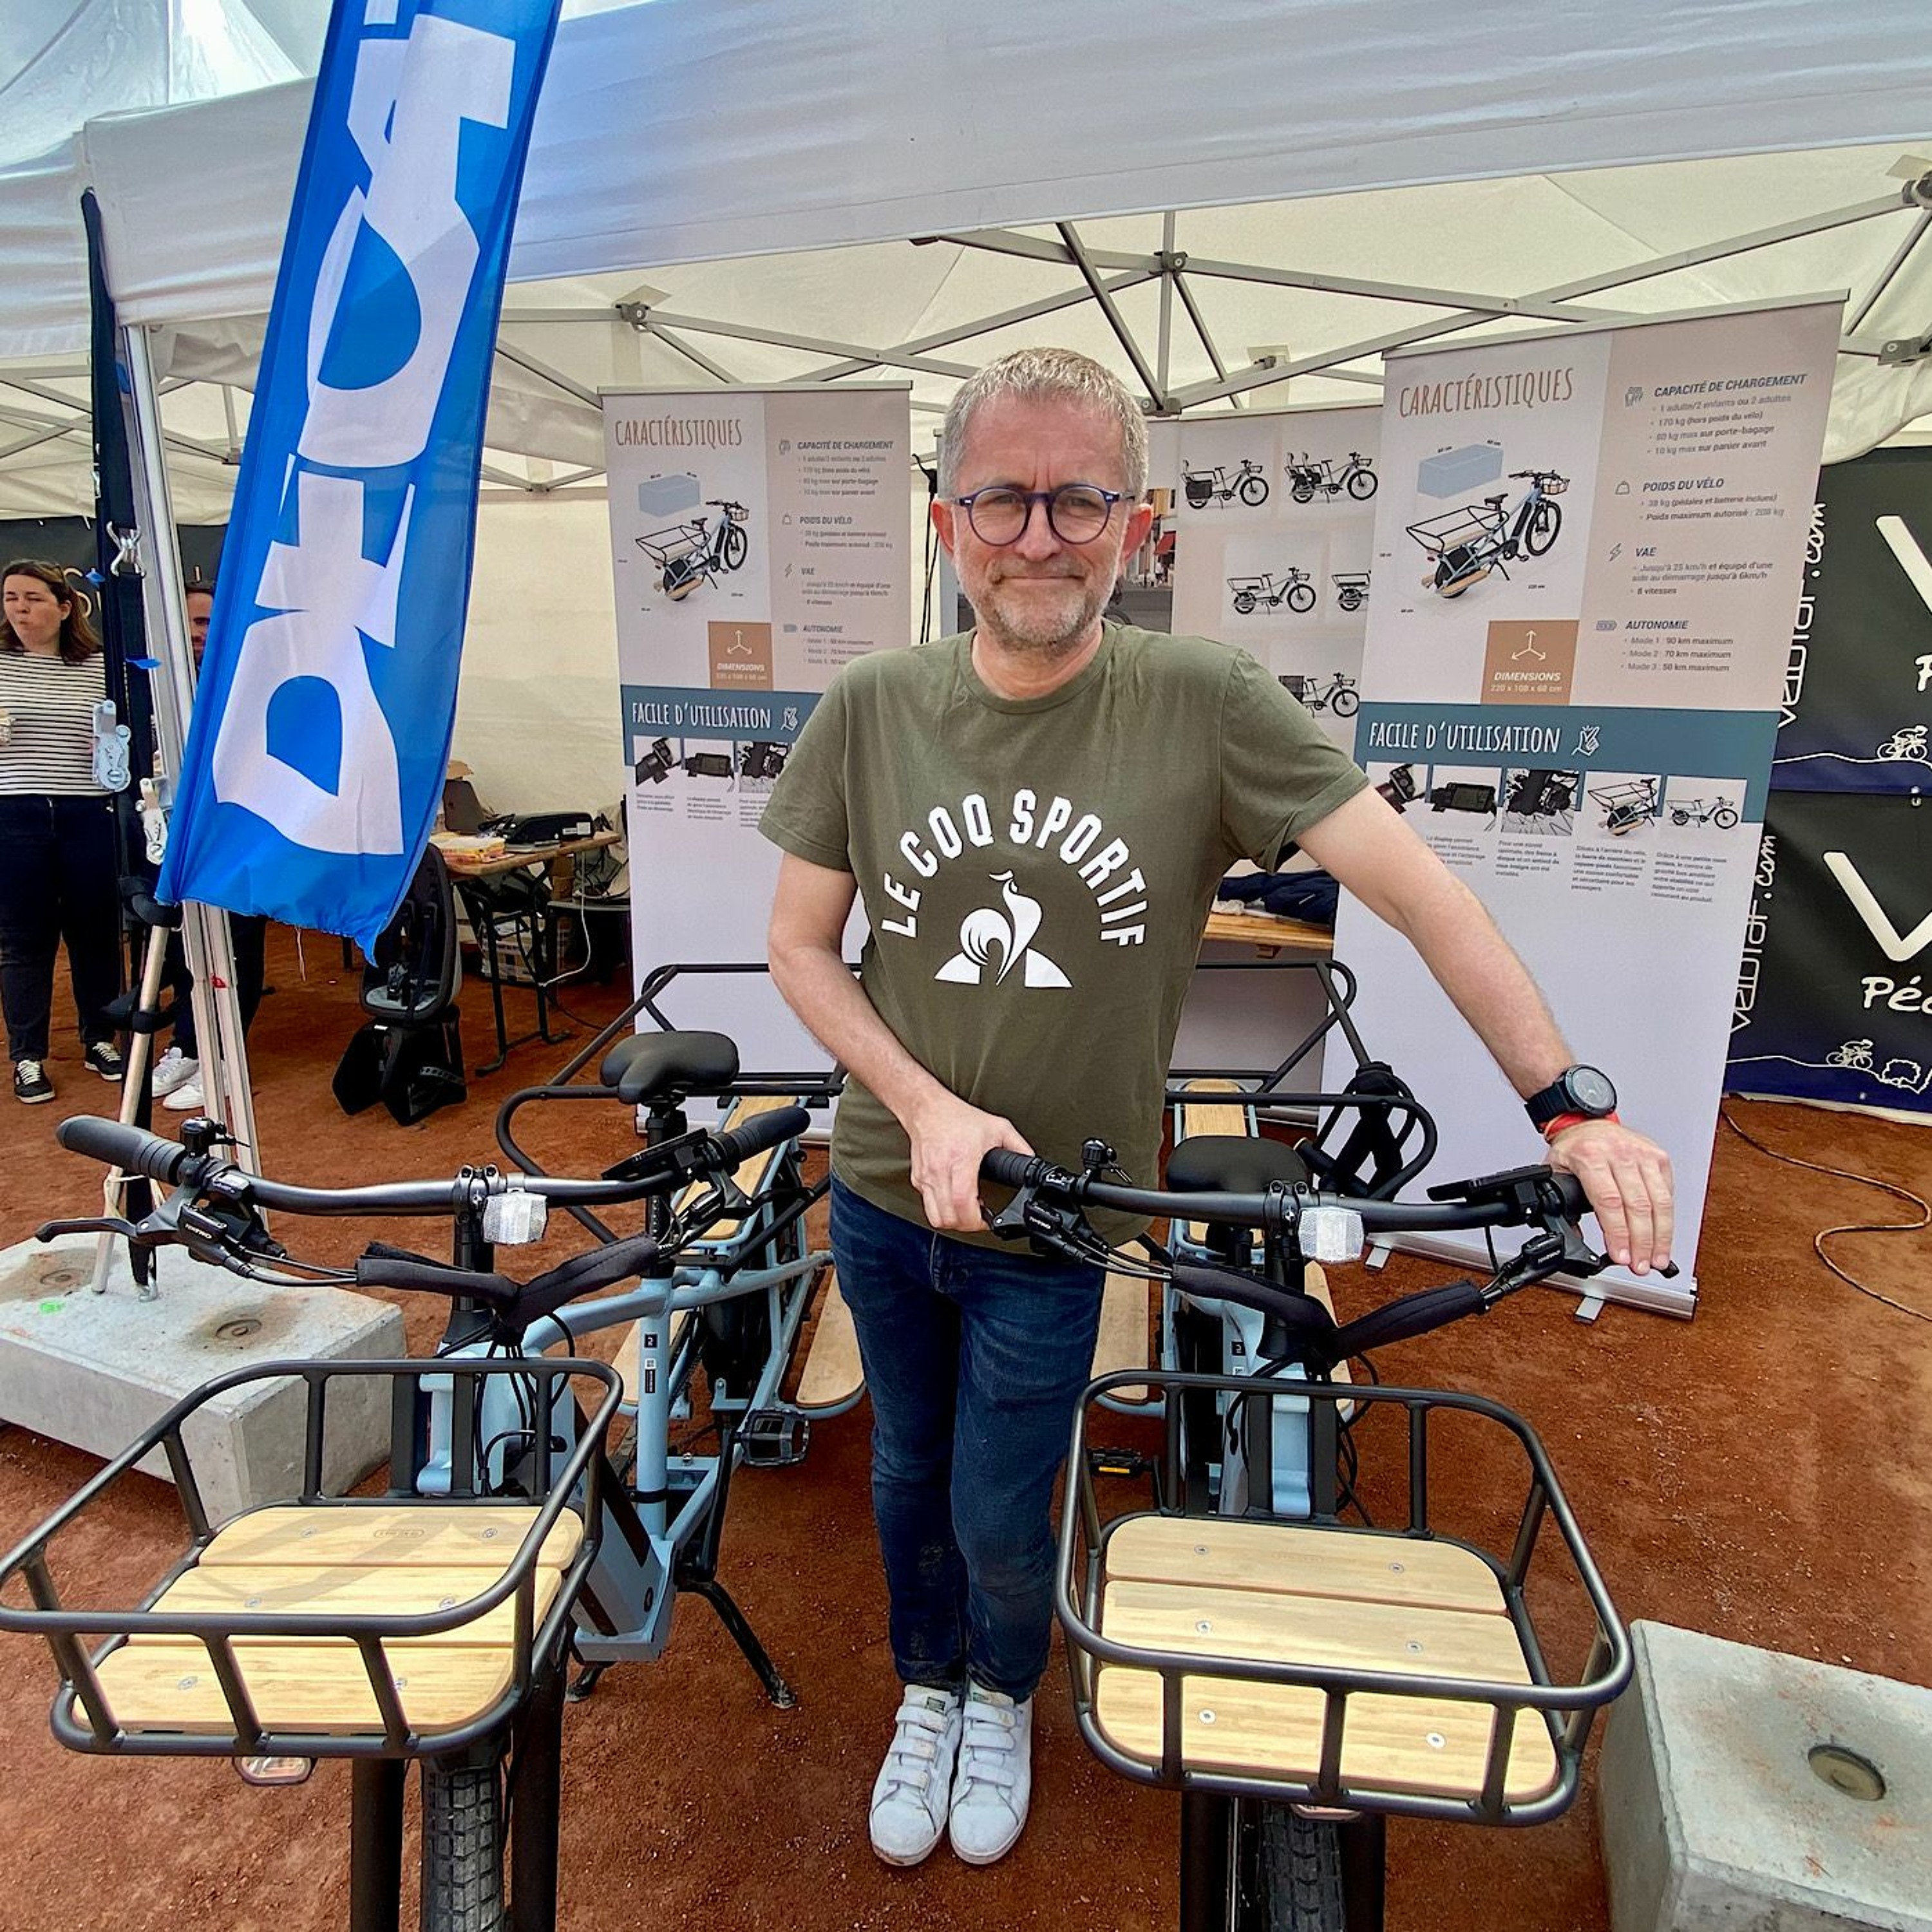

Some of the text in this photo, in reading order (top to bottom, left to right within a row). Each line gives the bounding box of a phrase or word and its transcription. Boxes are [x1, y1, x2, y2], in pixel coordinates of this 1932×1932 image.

[1654, 374, 1808, 398] CAPACITÉ DE CHARGEMENT
[1400, 368, 1574, 418] CARACTÉRISTIQUES
[1675, 417, 1685, 427] kg
[616, 415, 742, 450] CARACTÉRISTIQUES
[1669, 431, 1679, 441] kg
[1715, 425, 1775, 439] porte-bagage
[832, 441, 842, 450] DE
[844, 440, 894, 450] CHARGEMENT
[1667, 445, 1676, 455] kg
[1713, 442, 1741, 453] panier
[1742, 440, 1766, 449] avant
[1643, 477, 1725, 493] POIDS DU VÉLO
[1660, 498, 1670, 507] kg
[799, 516, 821, 525] POIDS
[822, 516, 833, 525] DU
[1671, 511, 1712, 520] maximum
[1636, 547, 1657, 557] VAE
[801, 567, 815, 576] VAE
[1644, 587, 1678, 595] vitesses
[803, 625, 844, 634] AUTONOMIE
[1625, 620, 1690, 630] AUTONOMIE
[1676, 650, 1689, 658] km
[1690, 650, 1732, 659] maximum
[1689, 663, 1730, 672] maximum
[1494, 672, 1561, 682] DIMENSIONS
[632, 703, 771, 729] FACILE D'UTILISATION
[1368, 721, 1560, 754] FACILE D'UTILISATION
[882, 788, 1148, 946] LE COQ SPORTIF
